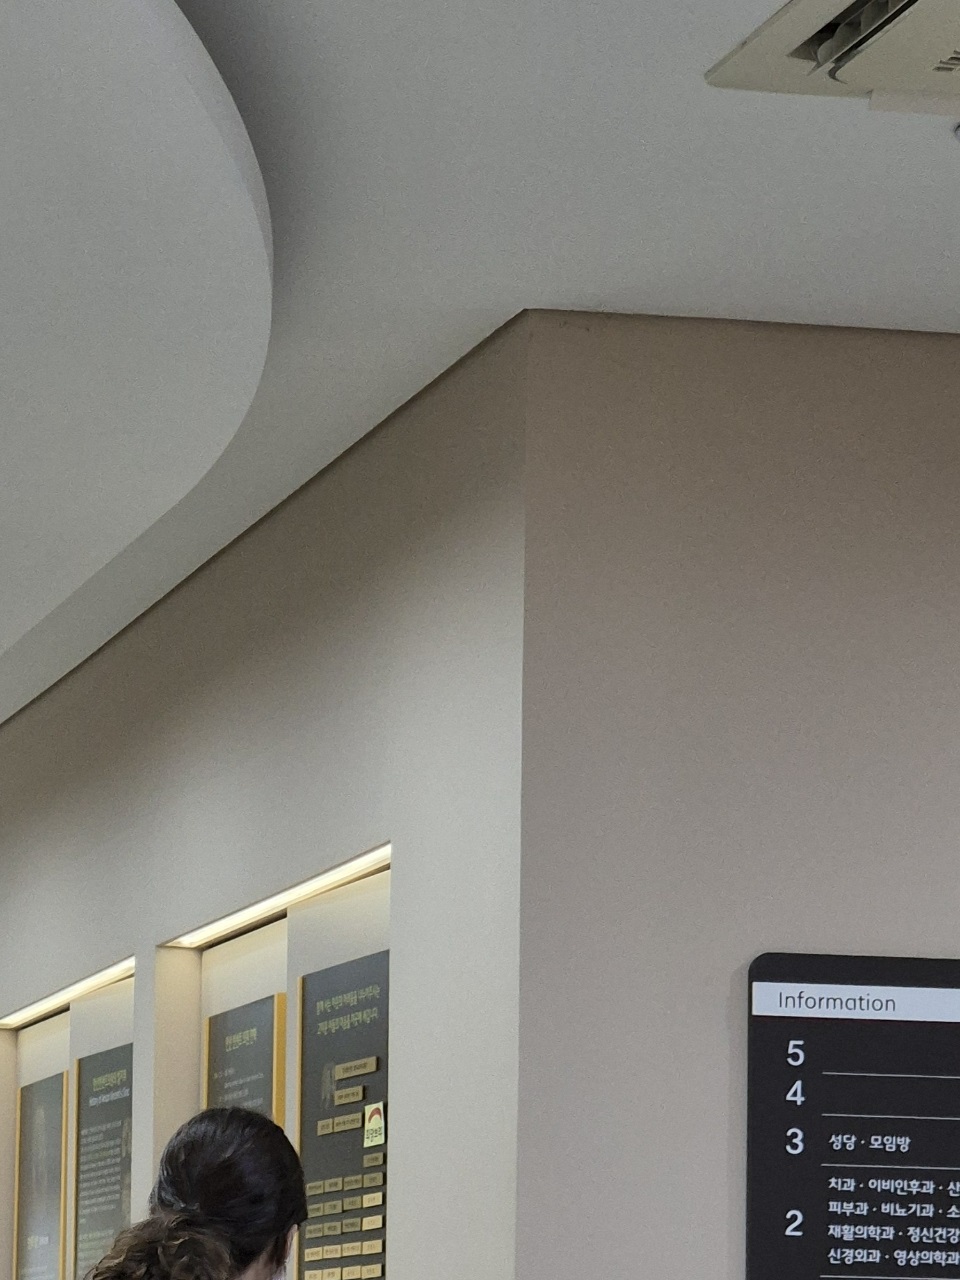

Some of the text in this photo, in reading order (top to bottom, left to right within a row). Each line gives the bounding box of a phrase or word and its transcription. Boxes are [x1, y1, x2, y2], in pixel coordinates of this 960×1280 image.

[779, 990, 896, 1012] Information
[786, 1040, 805, 1066] 5
[785, 1080, 806, 1105] 4
[785, 1128, 912, 1154] 3 성당 모임방
[828, 1177, 856, 1192] 치과
[868, 1179, 936, 1196] 이비인후과
[828, 1201, 869, 1217] 피부과
[881, 1203, 935, 1218] 비뇨기과
[785, 1209, 804, 1236] 2
[827, 1224, 960, 1243] 재활의학과 정신건강
[827, 1247, 960, 1267] 신경외과 영상의학과
